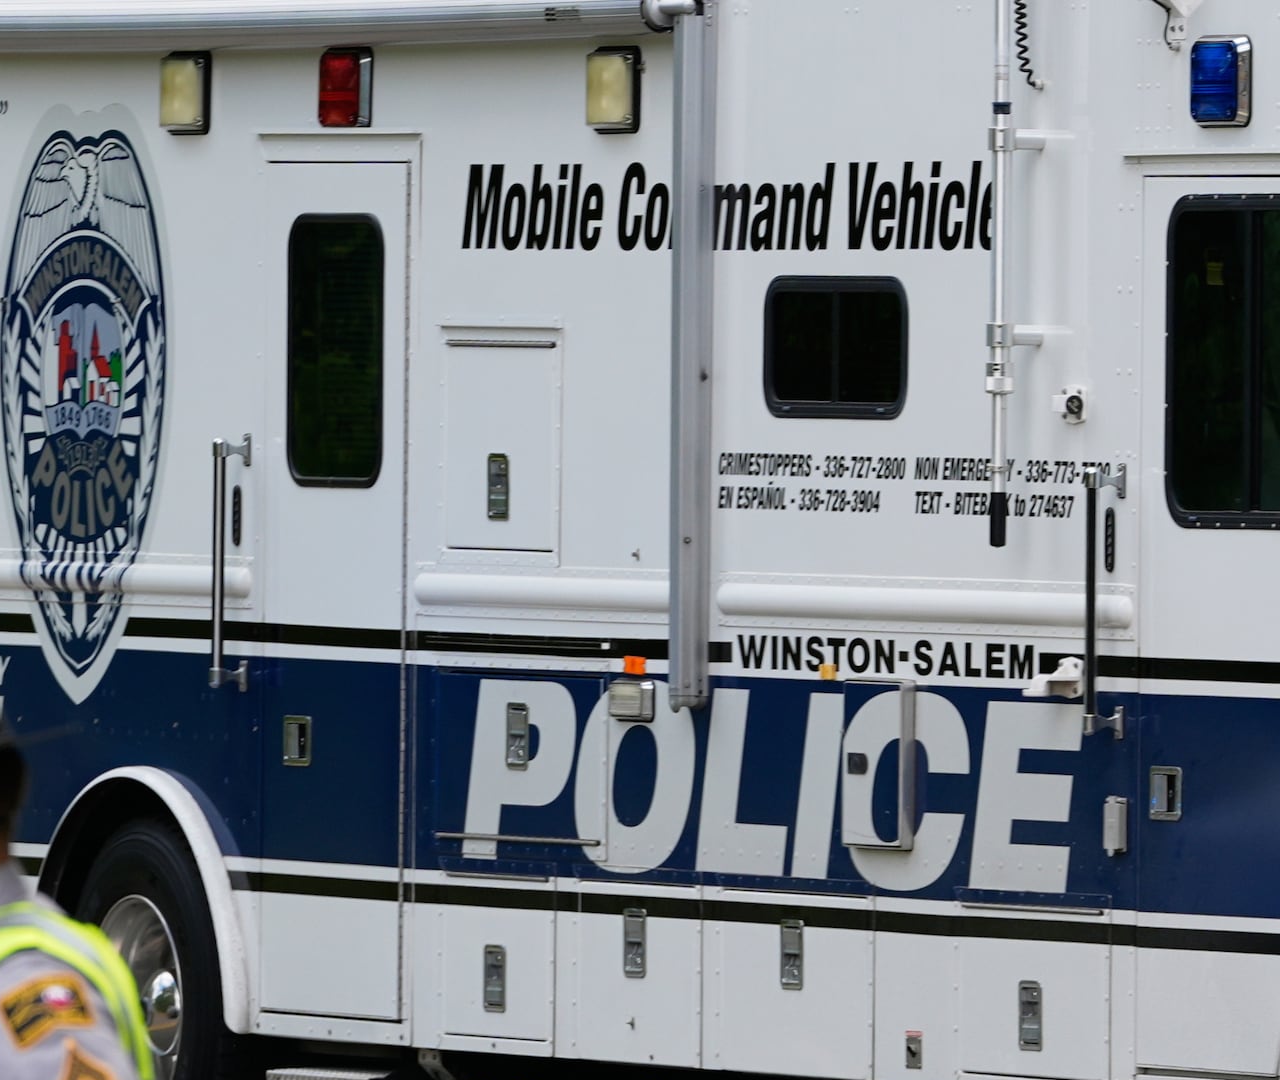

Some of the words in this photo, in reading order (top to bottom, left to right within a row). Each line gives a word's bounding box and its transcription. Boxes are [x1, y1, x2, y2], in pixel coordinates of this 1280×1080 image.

[461, 163, 603, 251] Mobile
[619, 162, 836, 252] Comand
[24, 242, 146, 315] WINSTON-SALEM
[54, 405, 81, 429] 1849
[85, 409, 111, 429] 1766
[719, 453, 812, 477] CRIMESTOPPERS
[823, 456, 906, 480] 336-727-2800
[915, 457, 940, 480] NON
[943, 457, 1015, 481] EMERGEY
[32, 440, 133, 539] POLICE
[718, 486, 734, 509] EN
[737, 482, 786, 510] ESPAÑOL
[799, 489, 880, 513] 336-728-3904
[915, 491, 943, 514] TEXT
[1015, 494, 1026, 516] to
[1029, 495, 1074, 518] 274637
[736, 633, 1036, 679] WINSTON-SALEM
[462, 678, 1083, 892] POLICE
